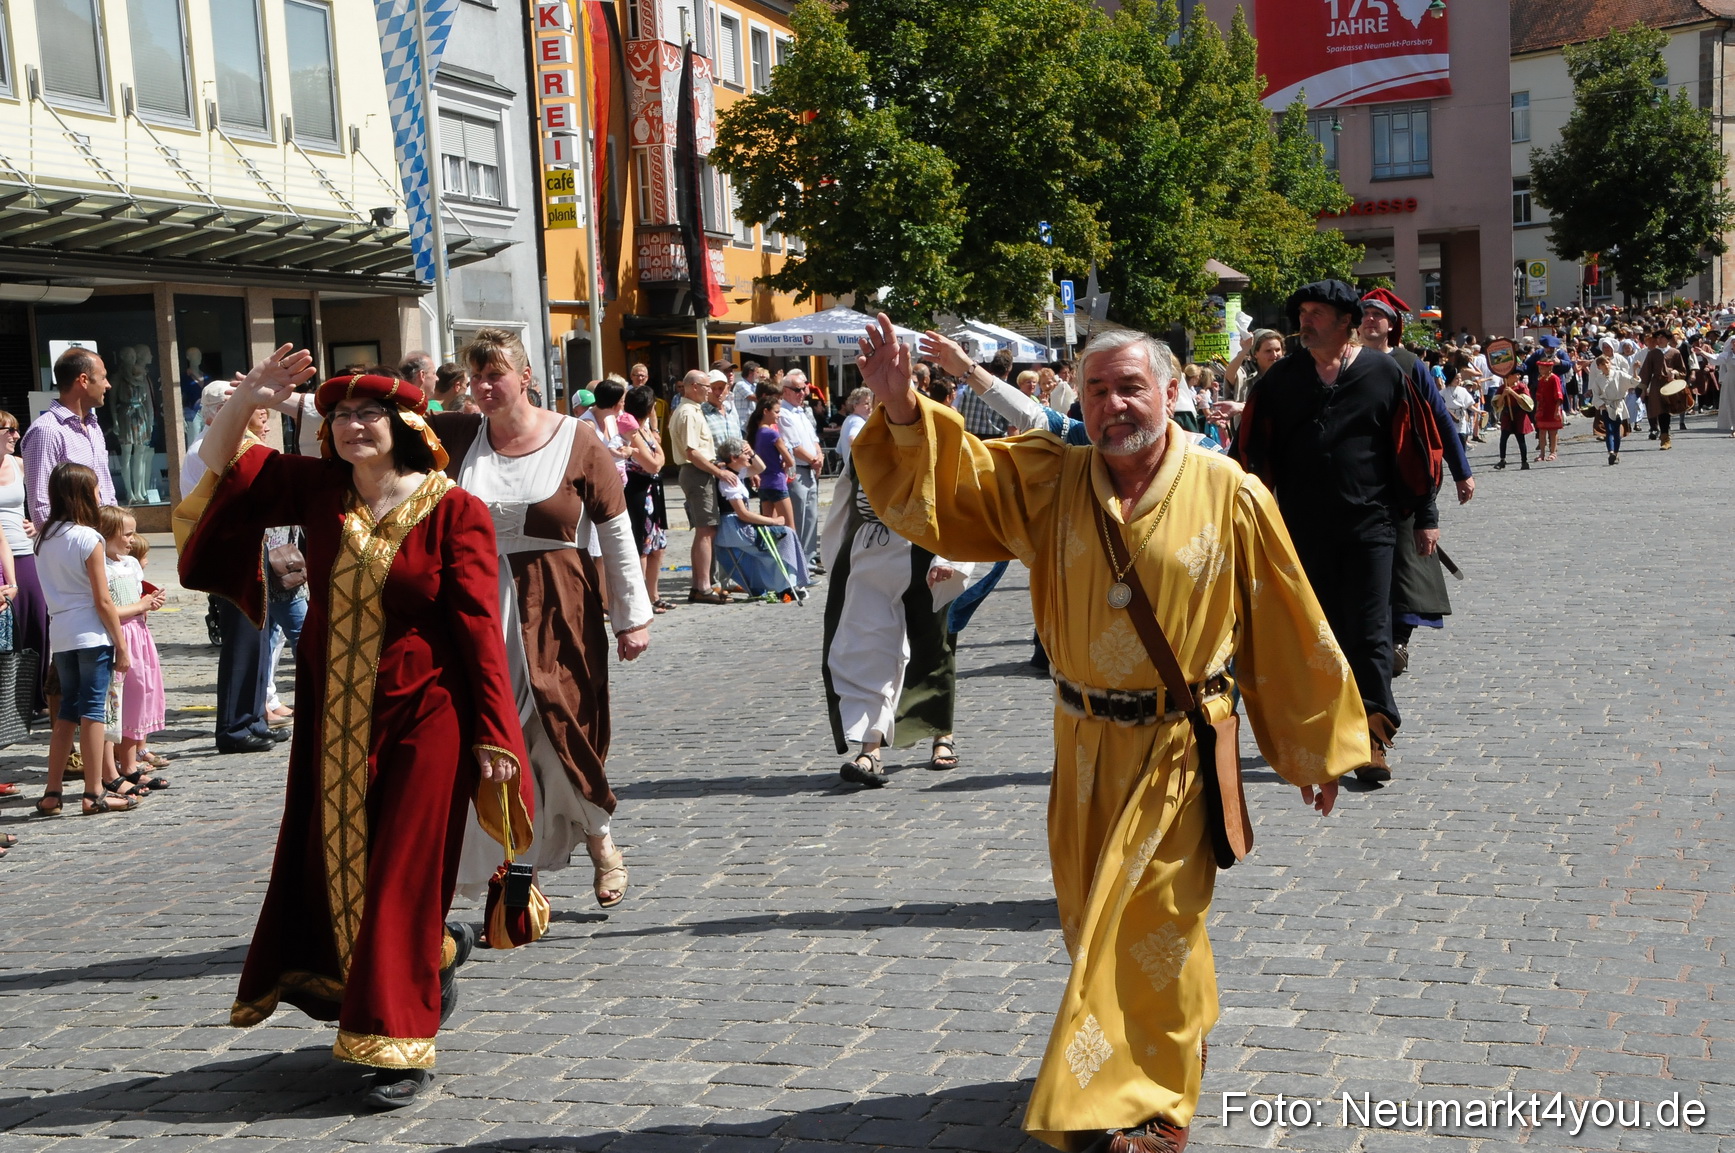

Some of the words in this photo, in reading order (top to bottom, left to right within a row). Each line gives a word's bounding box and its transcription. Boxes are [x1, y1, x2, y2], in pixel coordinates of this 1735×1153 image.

[1326, 17, 1389, 37] JAHRE
[1326, 45, 1363, 54] Sparkasse
[1364, 39, 1433, 50] Neumarkt-Parsberg
[539, 6, 565, 160] KEREI
[546, 172, 575, 191] café
[548, 207, 577, 226] plank
[1064, 285, 1071, 306] P
[748, 335, 781, 343] Winkler
[783, 335, 802, 343] Bräu
